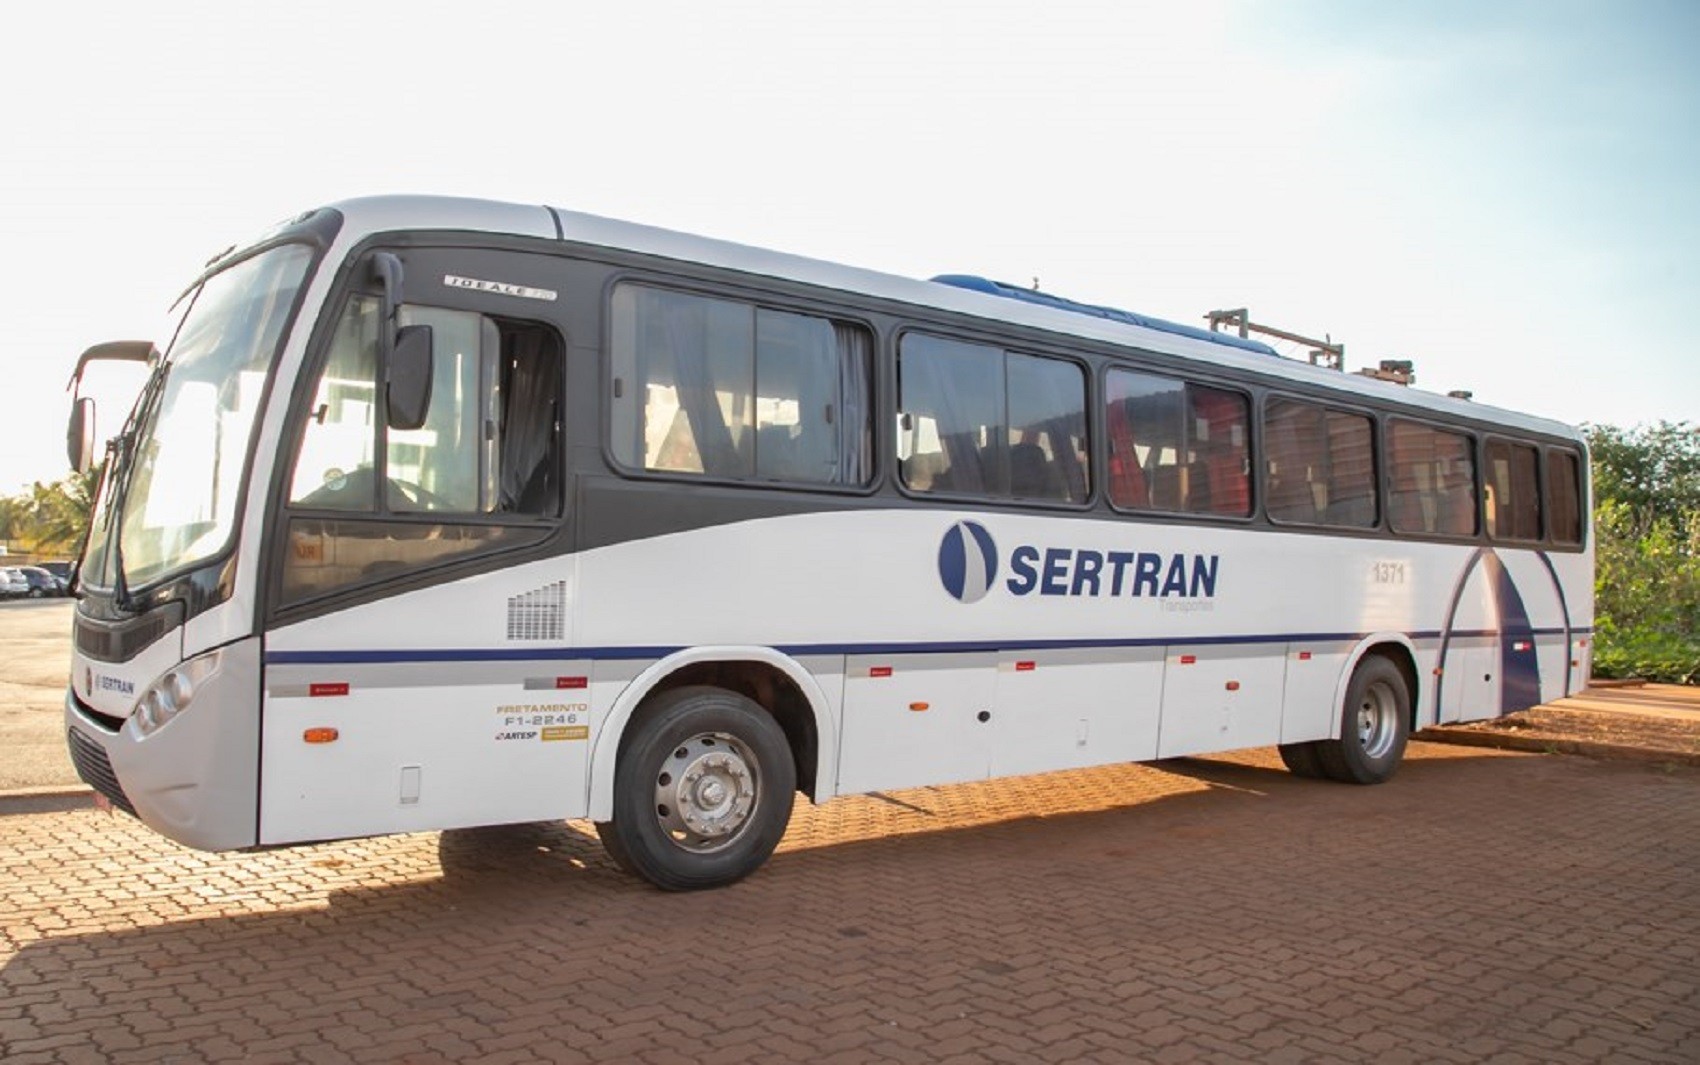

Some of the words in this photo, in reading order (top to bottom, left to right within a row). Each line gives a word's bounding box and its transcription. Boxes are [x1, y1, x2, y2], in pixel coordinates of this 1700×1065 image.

[1006, 545, 1219, 598] SERTRAN
[1372, 561, 1405, 584] 1371
[496, 702, 588, 714] FRETAMENTO
[505, 713, 577, 726] F1-2246
